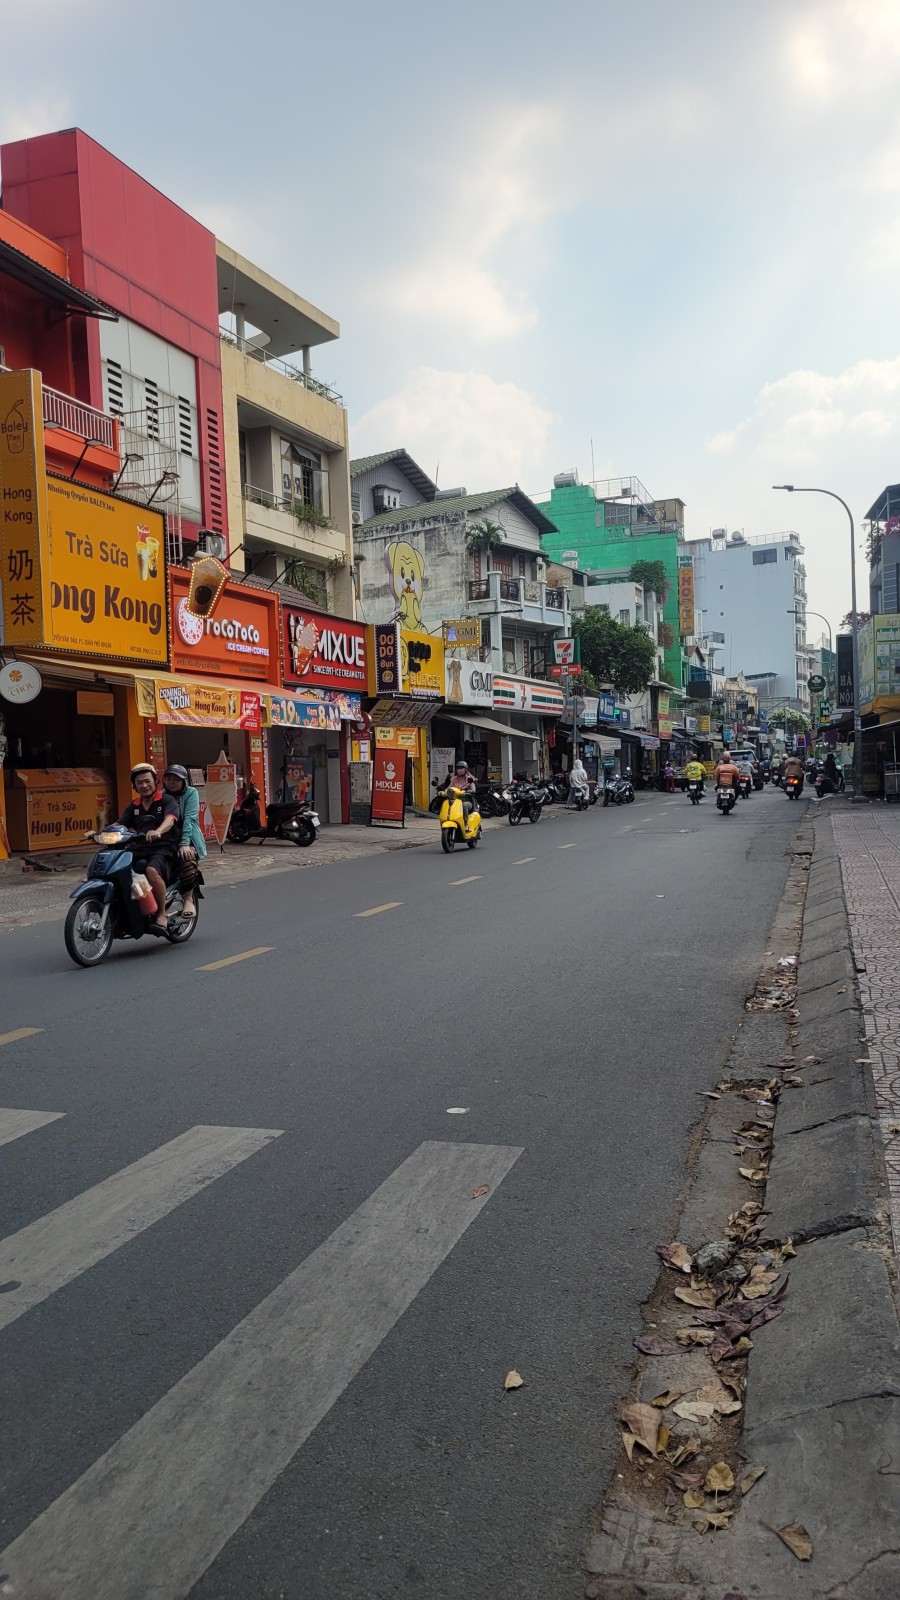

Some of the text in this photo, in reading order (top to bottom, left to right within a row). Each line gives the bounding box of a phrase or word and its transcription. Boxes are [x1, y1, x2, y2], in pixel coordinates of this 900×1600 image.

[4, 487, 32, 500] Hong
[5, 510, 33, 524] Kong
[65, 530, 129, 568] Trà Sữa
[51, 581, 162, 635] ong Kong
[681, 576, 692, 630] HOTEL
[457, 627, 476, 636] GMI
[314, 629, 365, 667] MIXUE
[470, 670, 492, 692] GMI
[840, 672, 852, 686] HÀ
[160, 687, 182, 699] COMING
[839, 689, 854, 705] NỘI
[170, 694, 191, 710] SOON
[194, 701, 226, 715] Hong Kong
[375, 780, 402, 790] MIXUE
[47, 800, 76, 812] Trà Sữa
[31, 817, 93, 837] Hong Kong
